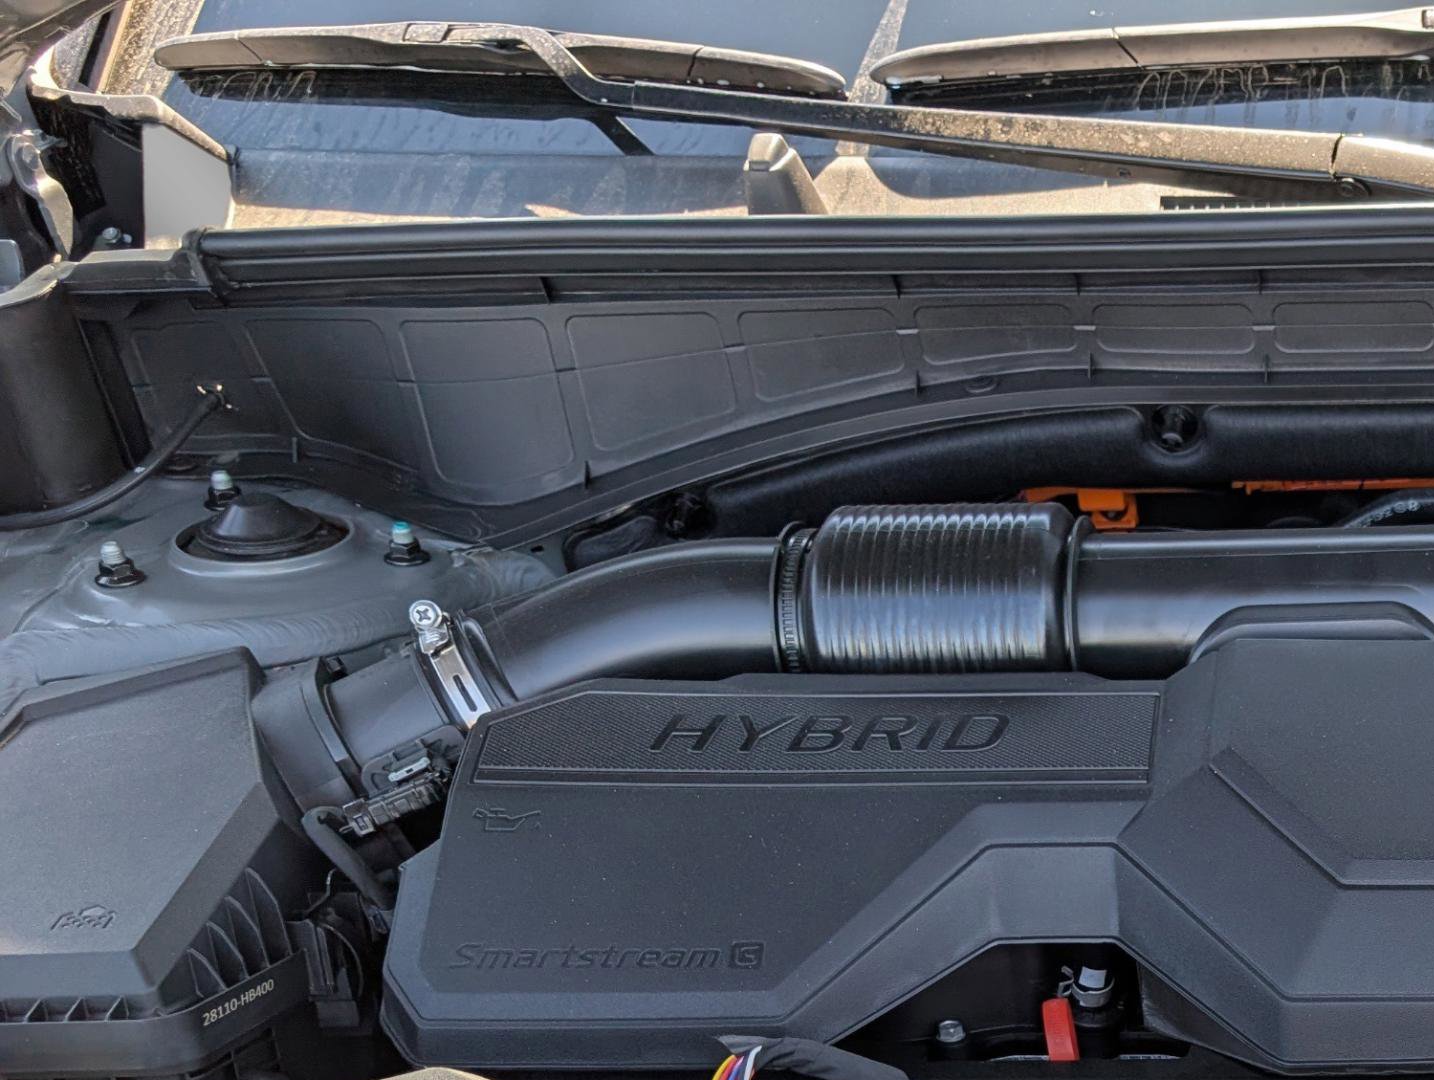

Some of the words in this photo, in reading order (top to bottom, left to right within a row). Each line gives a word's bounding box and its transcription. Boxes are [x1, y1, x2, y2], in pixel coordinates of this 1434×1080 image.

[650, 714, 1010, 752] HYBRID
[449, 942, 721, 969] Smartstream
[202, 979, 274, 1026] 28110-HB400
